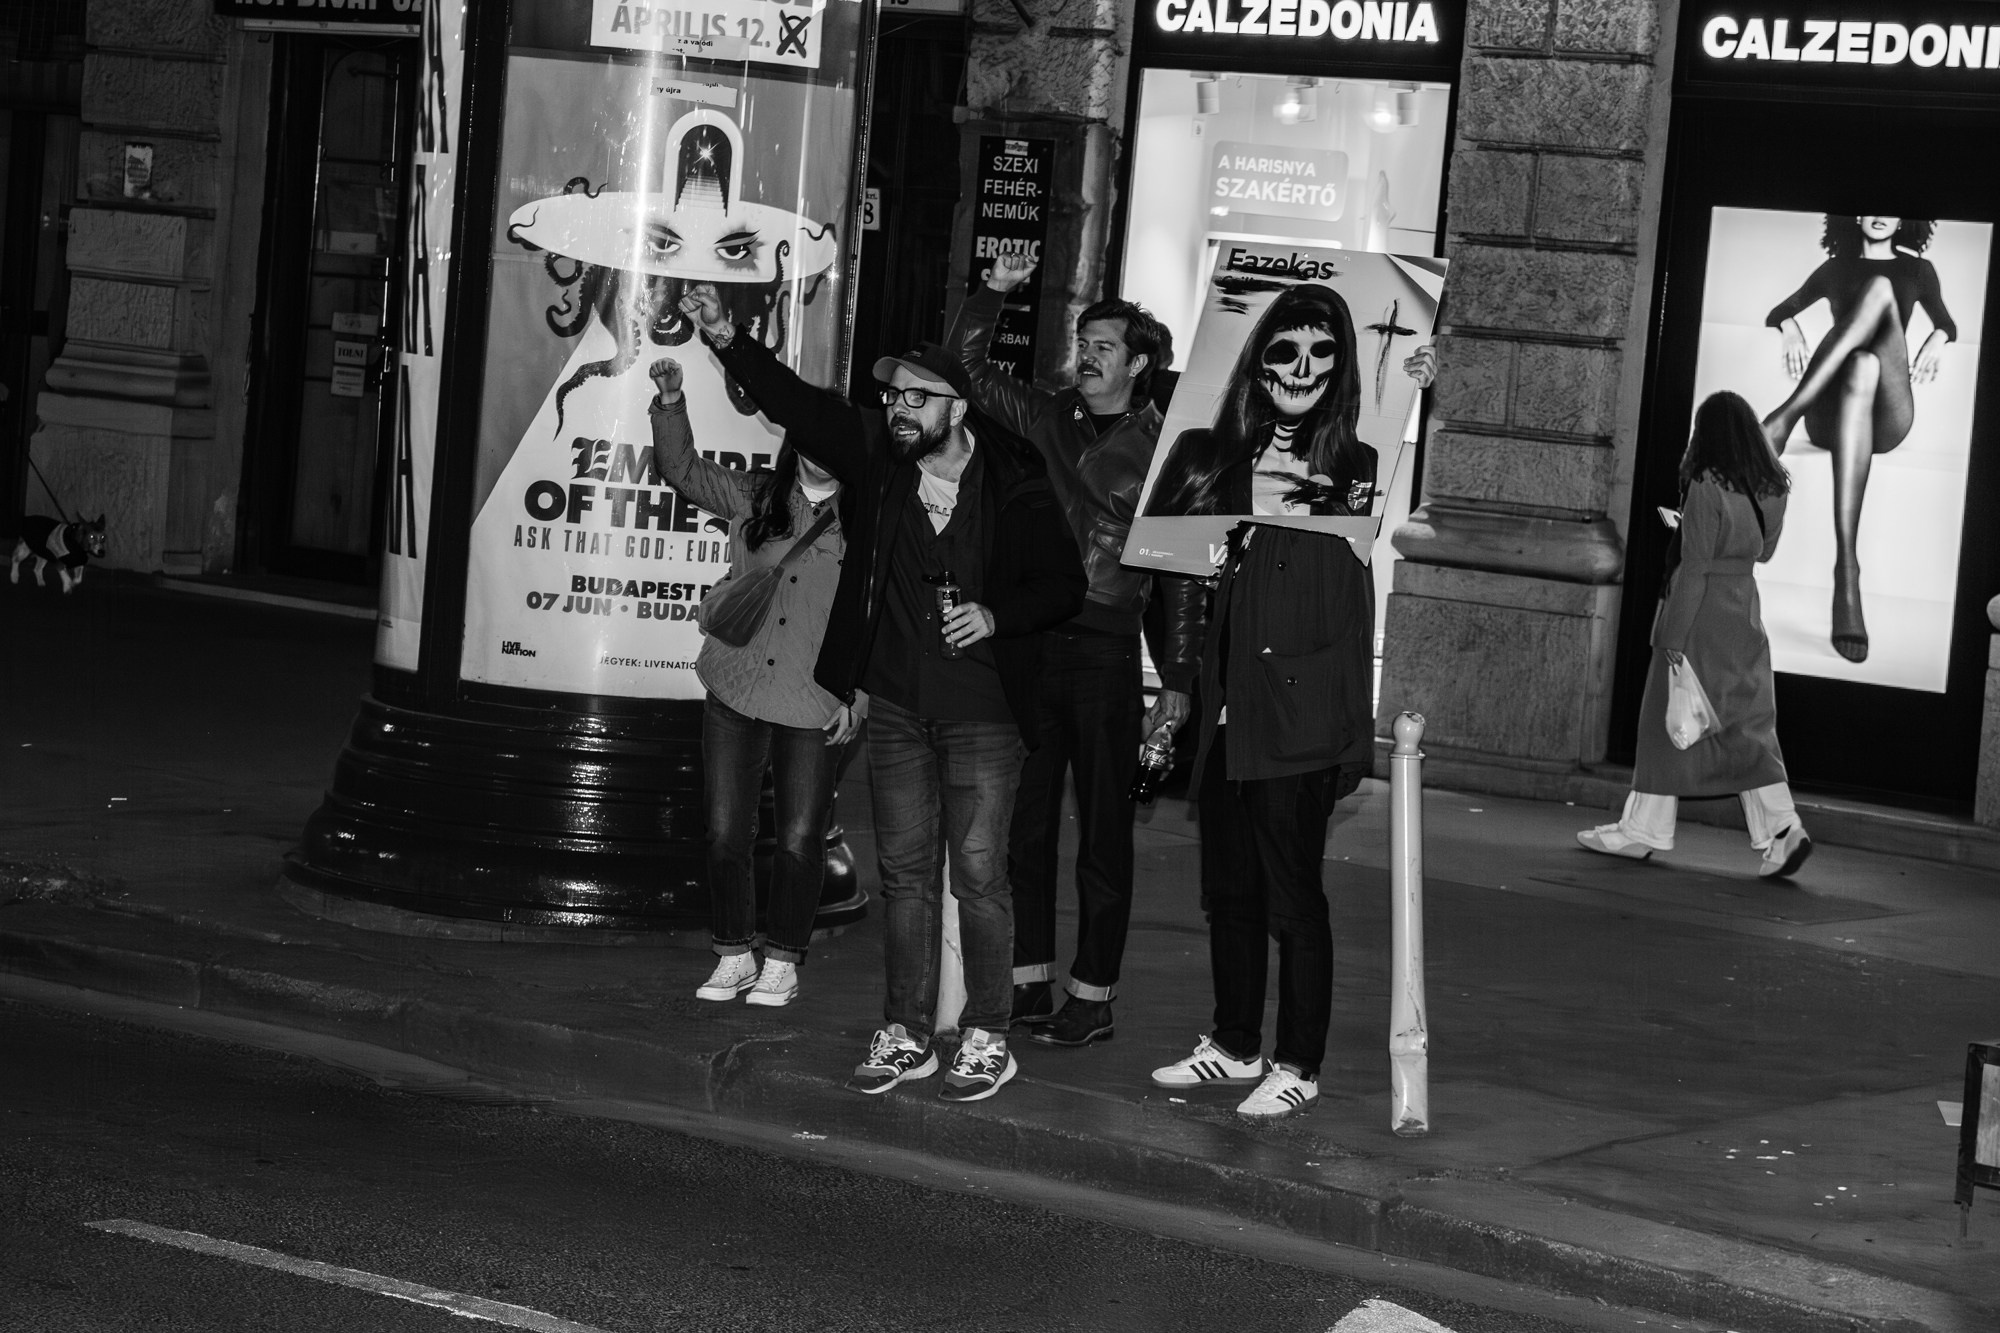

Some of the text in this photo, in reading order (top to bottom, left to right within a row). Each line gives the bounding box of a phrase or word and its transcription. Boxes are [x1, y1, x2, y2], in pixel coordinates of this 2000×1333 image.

[611, 0, 771, 48] ÁPRILIS 12.
[1155, 0, 1440, 42] CALZEDONIA
[1702, 15, 2000, 68] CALZEDONI
[993, 156, 1039, 174] SZEXI
[1218, 154, 1316, 177] A HARISNYA
[984, 178, 1042, 197] FEHÉR-
[1215, 177, 1336, 206] SZAKÉRTŐ
[982, 201, 1041, 221] NEMŰK
[976, 236, 1041, 263] EROTIC
[524, 479, 596, 524] OF
[604, 486, 699, 533] THE
[513, 525, 551, 550] ASK
[564, 529, 613, 556] THAT
[625, 535, 674, 561] GOD:
[571, 575, 696, 602] BUDAPEST
[526, 591, 560, 611] 07
[562, 595, 612, 617] JUN
[501, 648, 537, 658] NATION
[502, 640, 521, 650] LIVE
[600, 656, 641, 668] JEGYEK:
